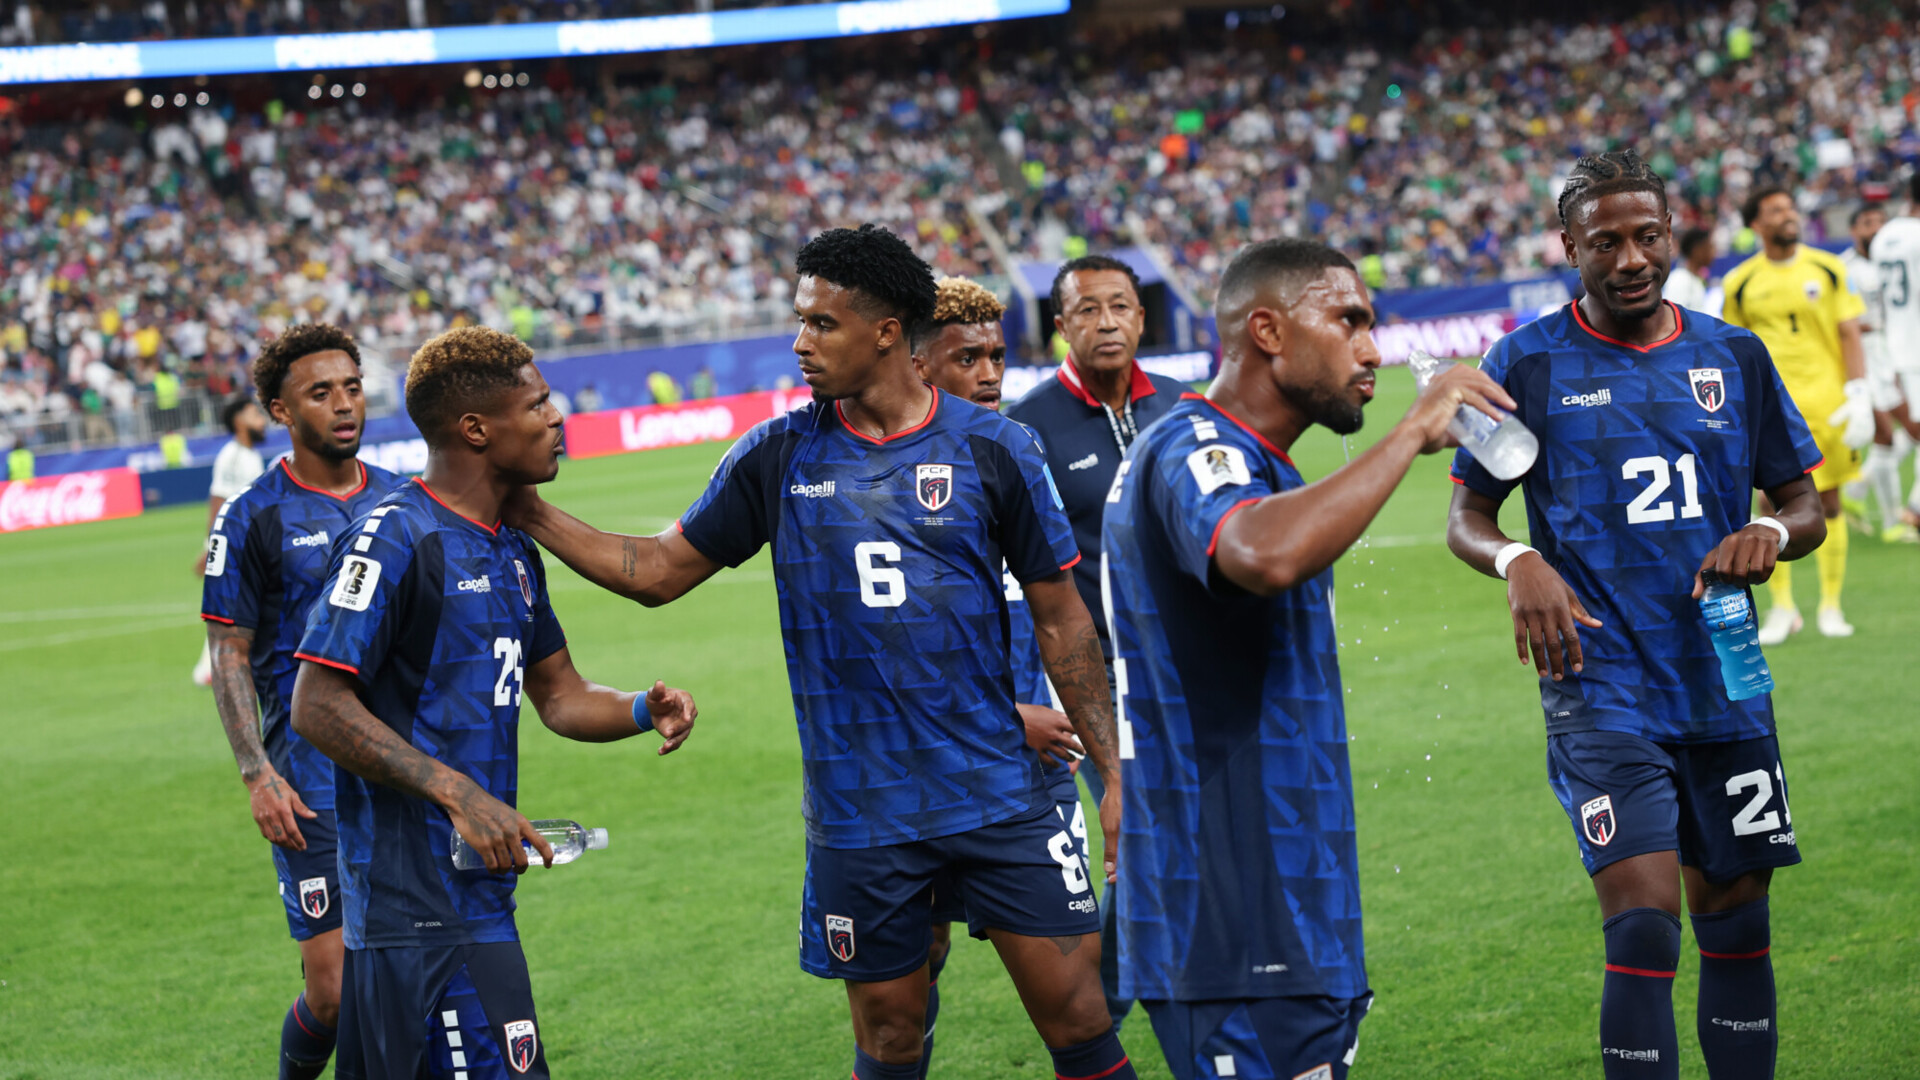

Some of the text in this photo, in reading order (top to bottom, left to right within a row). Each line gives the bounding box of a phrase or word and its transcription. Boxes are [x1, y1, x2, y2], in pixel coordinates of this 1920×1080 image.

[1789, 313, 1798, 333] 1
[1692, 370, 1719, 378] FCF
[1562, 388, 1611, 406] capelli
[620, 405, 734, 450] Lenovo
[920, 466, 949, 474] FCF
[791, 481, 835, 497] capelli
[1622, 453, 1703, 524] 21
[854, 541, 907, 607] 6
[457, 575, 490, 592] capelli
[494, 637, 523, 707] 25
[1583, 798, 1607, 814] FCF
[1725, 761, 1791, 836] 21
[1047, 830, 1089, 895] 6
[828, 917, 850, 927] FCF
[508, 1023, 530, 1034] FCF
[1712, 1018, 1769, 1031] capelli
